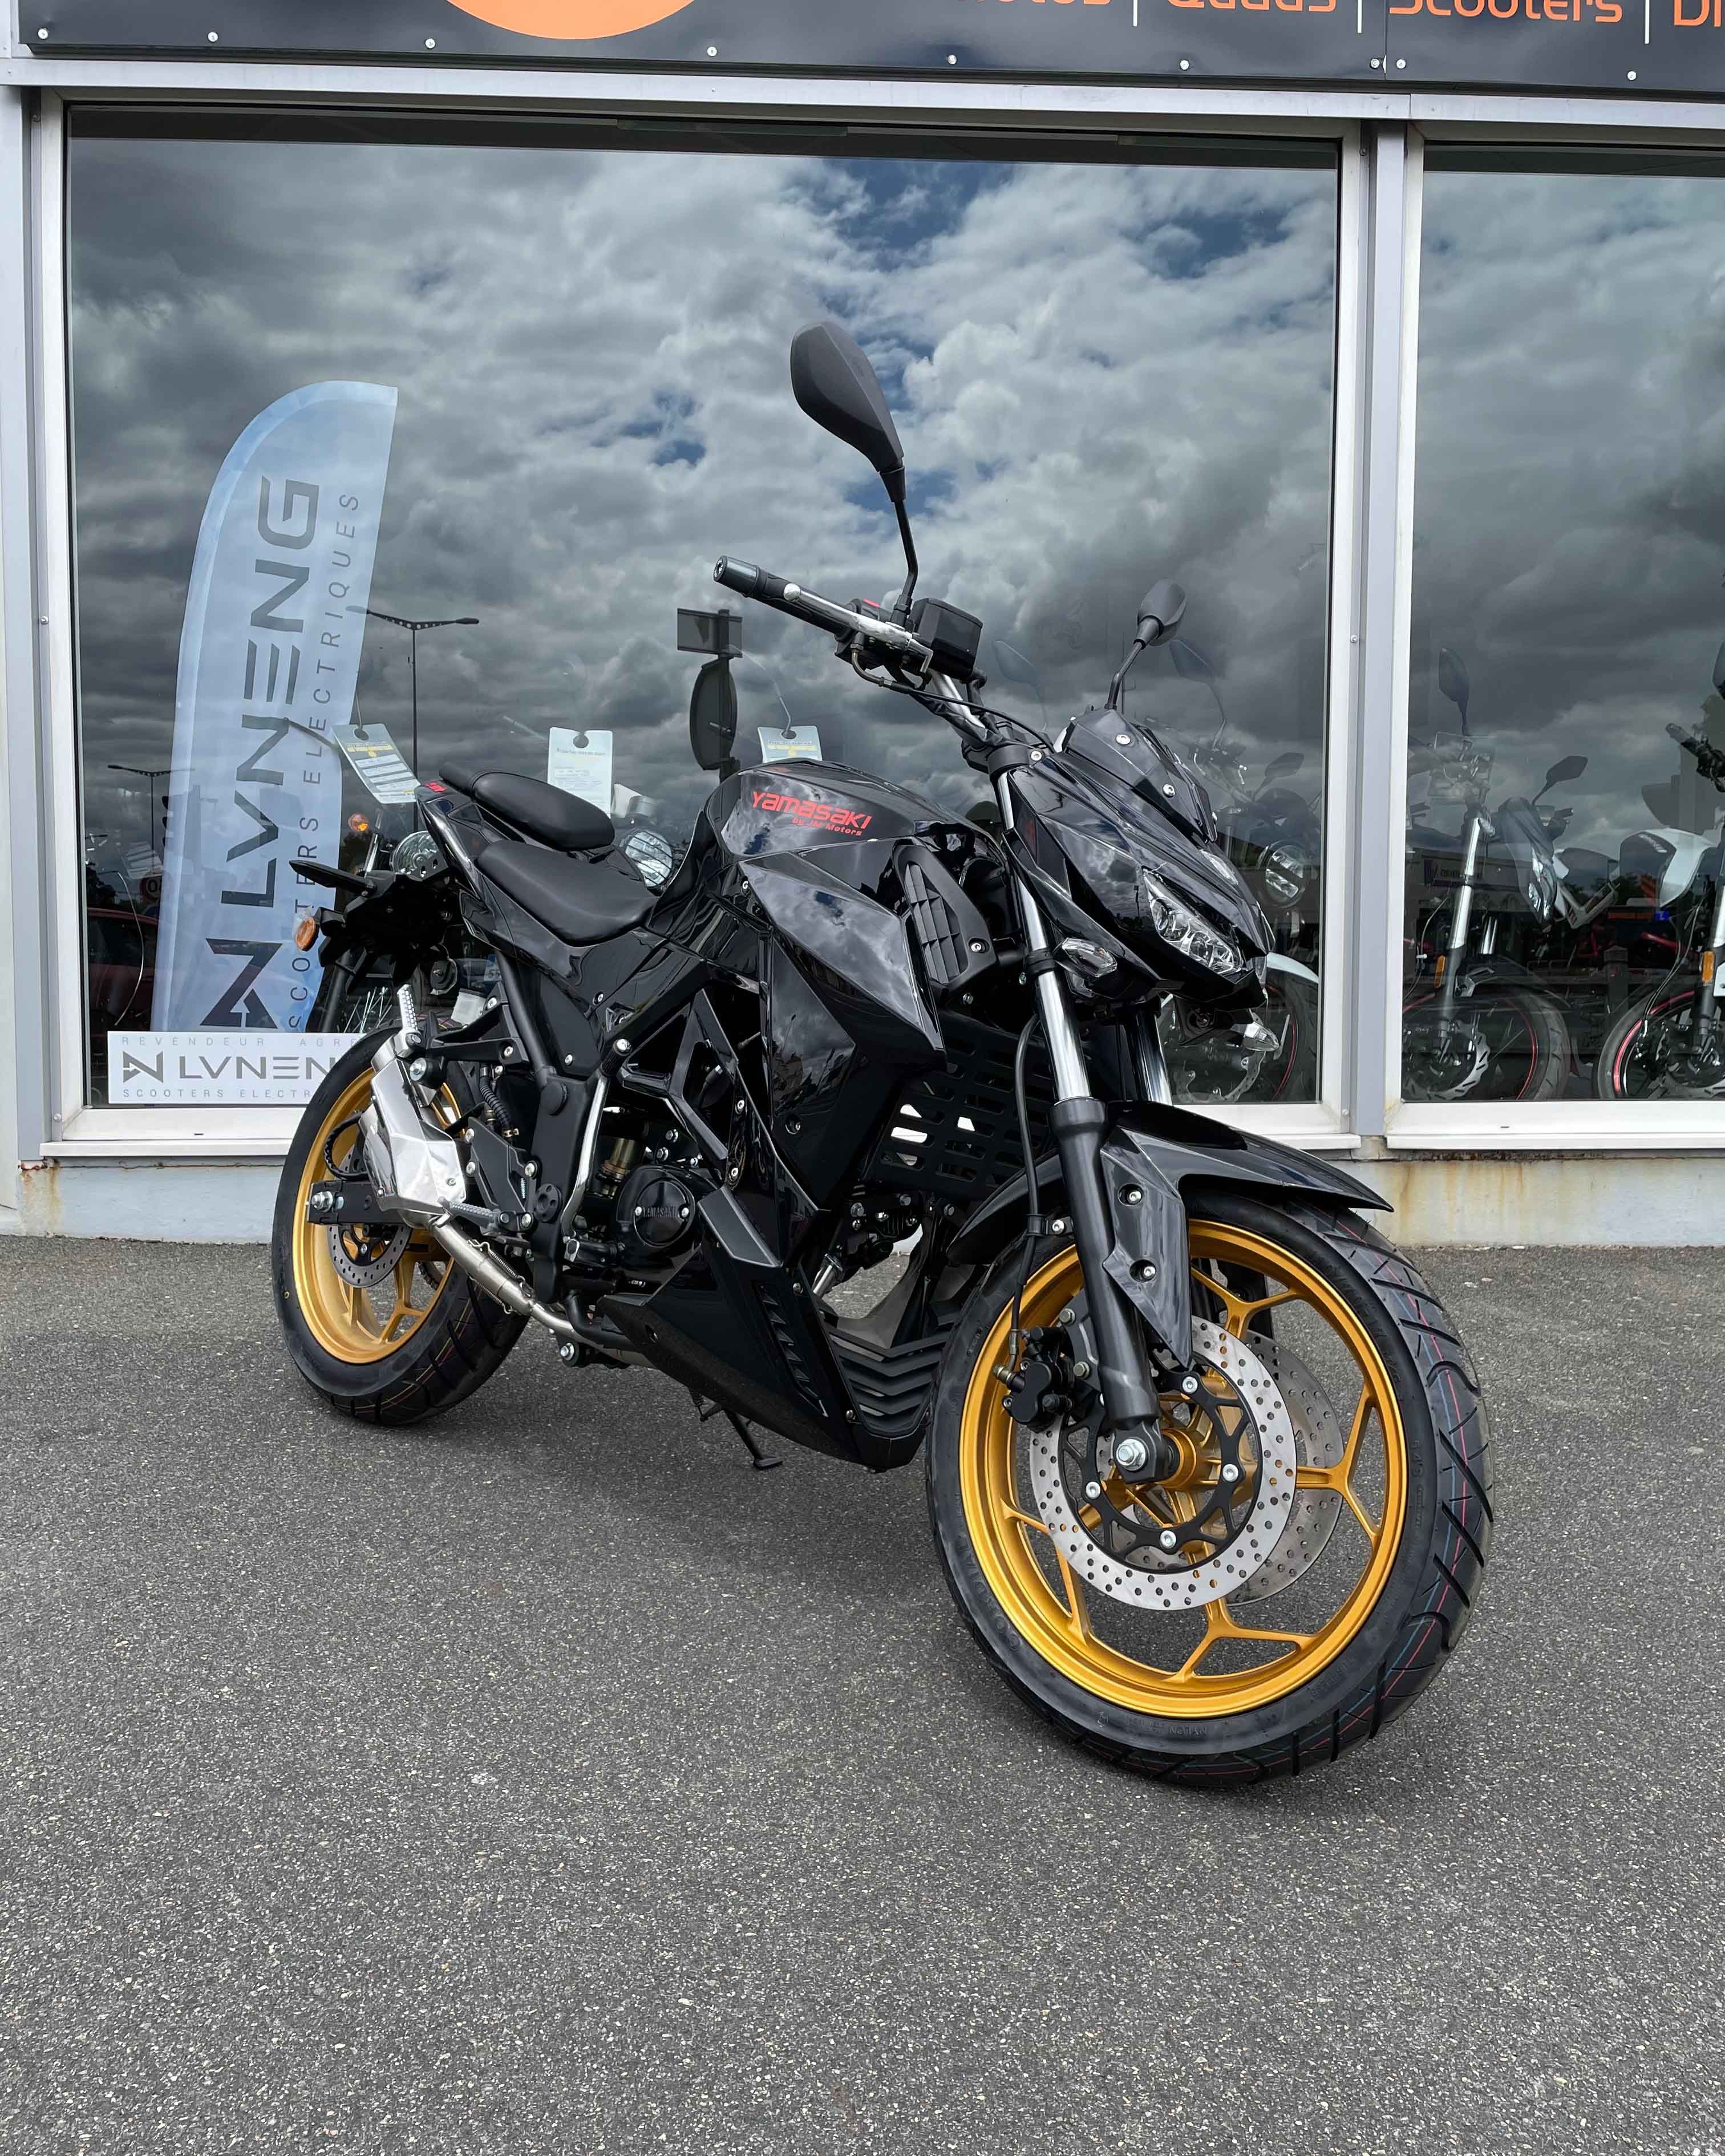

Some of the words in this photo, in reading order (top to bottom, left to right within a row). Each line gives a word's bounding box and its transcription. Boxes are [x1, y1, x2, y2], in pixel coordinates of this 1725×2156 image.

[303, 493, 359, 784] ELECTRIQUES
[825, 823, 862, 836] Motors
[288, 817, 319, 1028] SCOTERS
[122, 1036, 264, 1046] REVENDEUR
[123, 1089, 224, 1098] SCOOTERS
